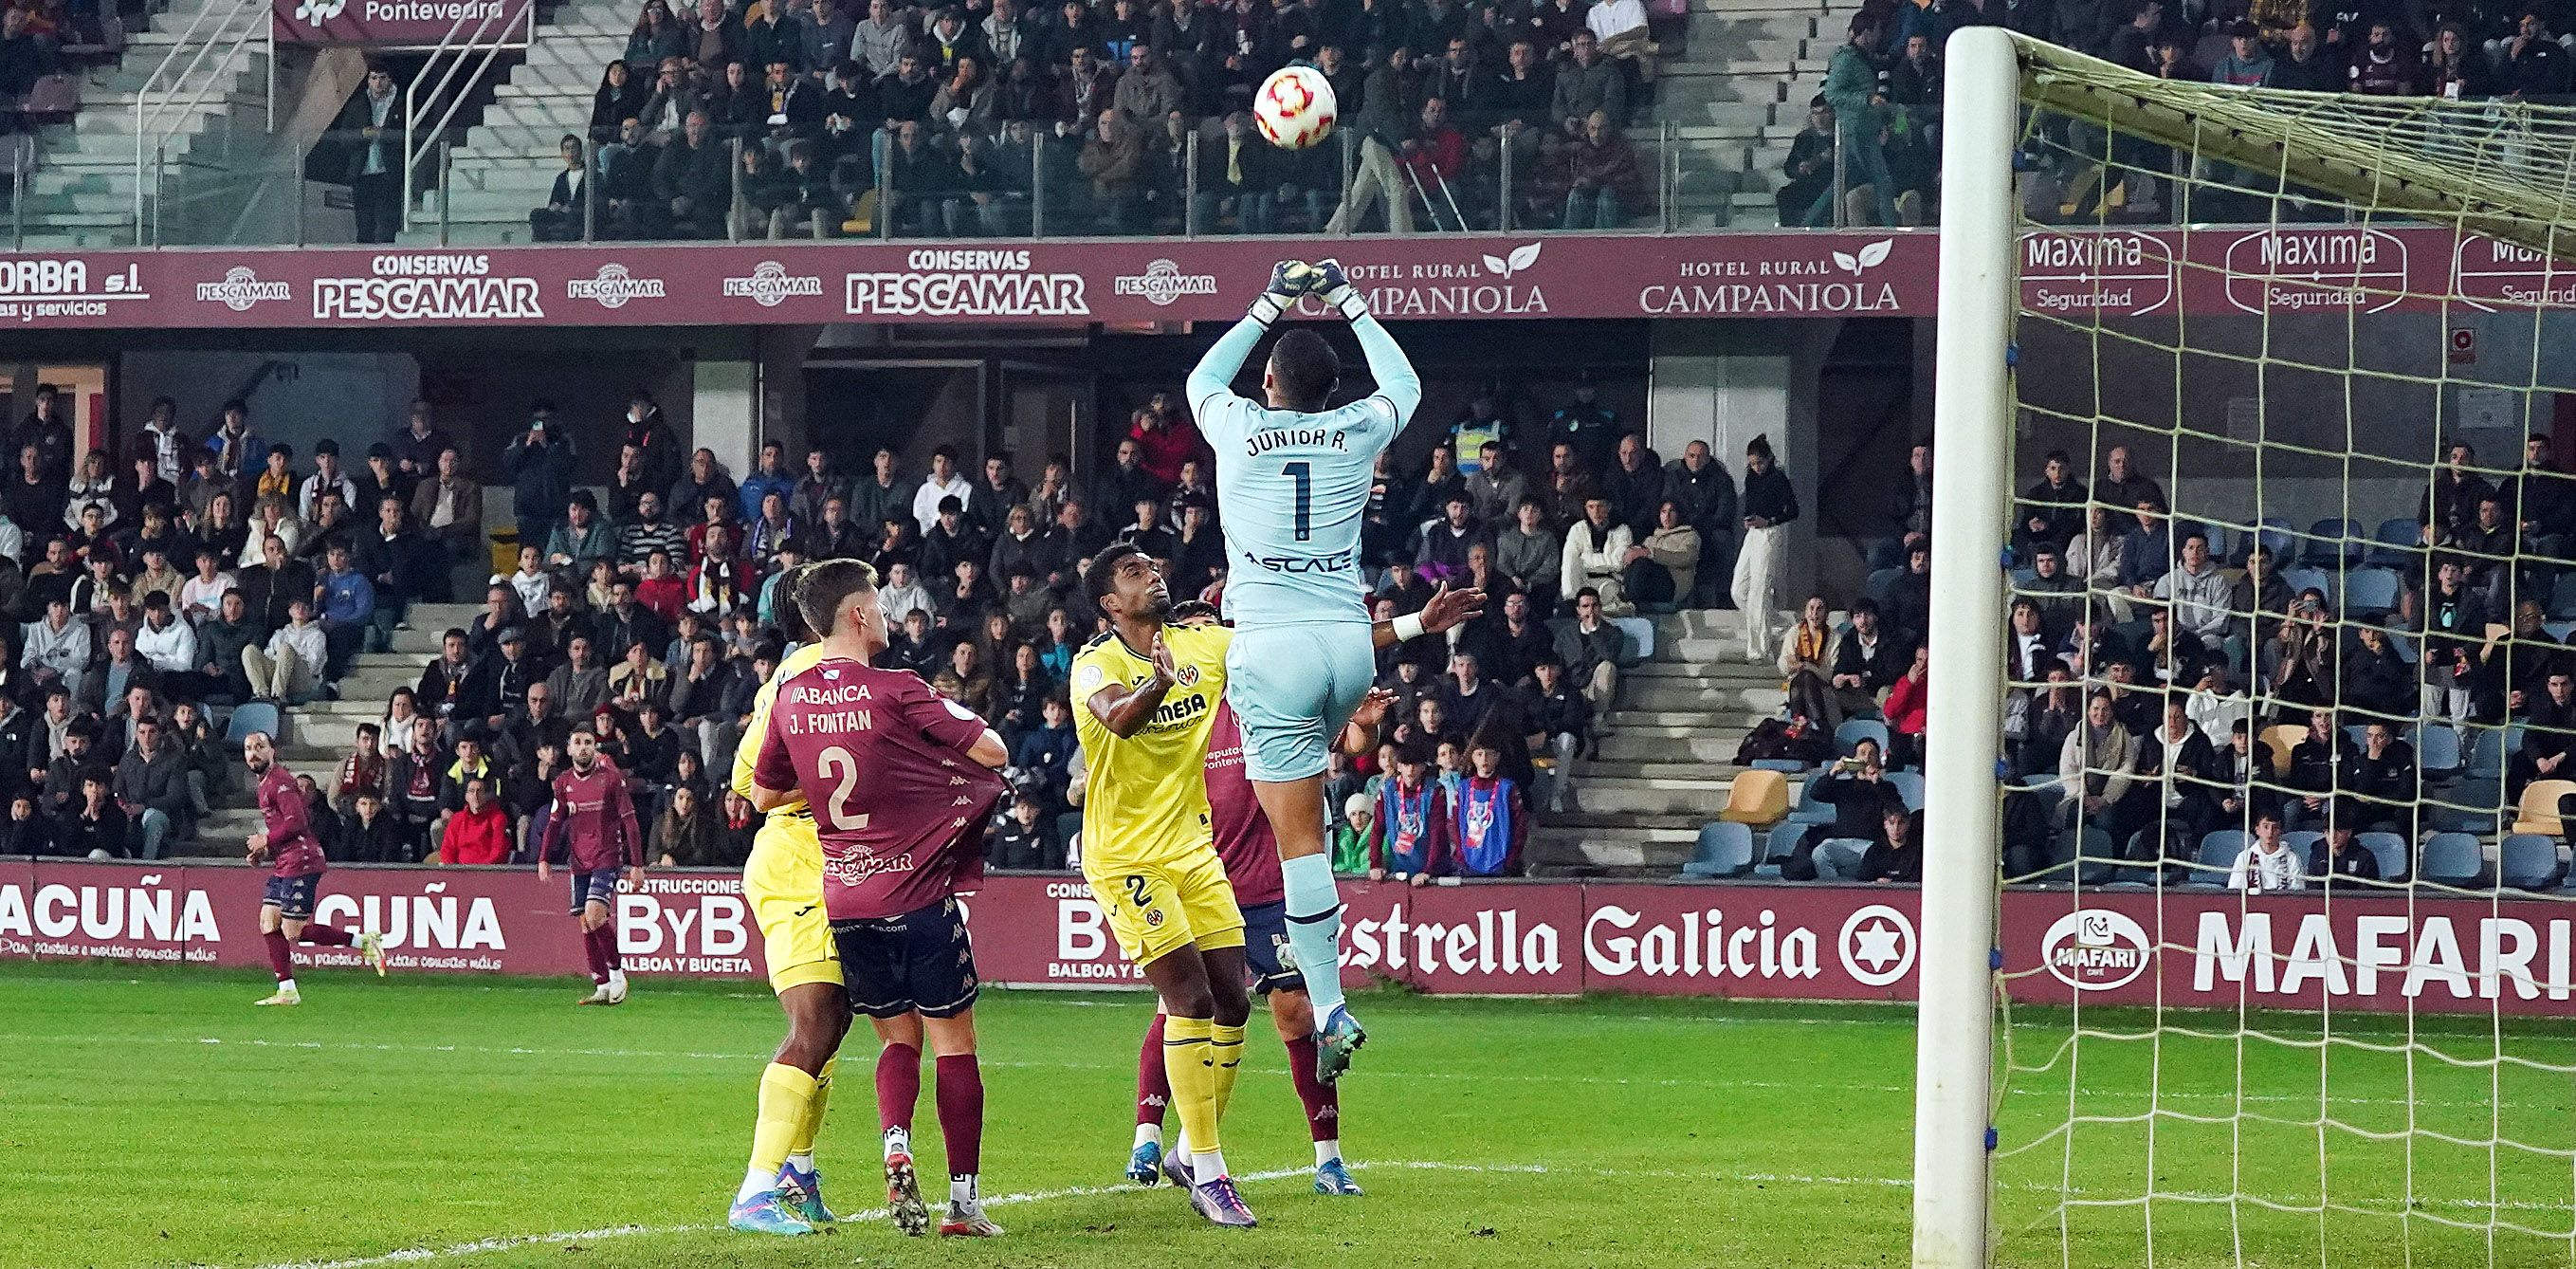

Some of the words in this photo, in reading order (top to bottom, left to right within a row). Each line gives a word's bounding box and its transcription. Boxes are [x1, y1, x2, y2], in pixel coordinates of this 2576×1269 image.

[372, 255, 489, 275] CONSERVAS
[907, 250, 1031, 270] CONSERVAS
[1413, 264, 1481, 279] RURAL
[1681, 262, 1750, 277] HOTEL
[1760, 261, 1830, 276] RURAL
[0, 259, 86, 293] ORBA
[104, 263, 142, 293] s.l.
[723, 275, 823, 296] PESCAMAR
[1115, 275, 1217, 295] PESCAMAR
[197, 282, 290, 300] PESCAMAR
[314, 279, 544, 319] PESCAMAR
[568, 279, 666, 299] PESCAMAR
[846, 273, 1089, 316] PESCAMAR
[1638, 283, 1900, 315] CAMPANIOLA
[2037, 288, 2132, 311] Seguridad
[2270, 287, 2366, 310] Seguridad
[22, 303, 32, 322] y
[36, 301, 107, 316] servicios
[1280, 461, 1311, 542] 1
[1153, 693, 1207, 724] MESA
[789, 715, 804, 735] J.
[808, 709, 872, 734] FONTAN
[817, 745, 869, 831] 2
[825, 853, 914, 875] ESCAMAR
[616, 879, 745, 894] OSTRUCCIONE
[1125, 874, 1153, 907] 2
[0, 875, 221, 942] ACUÑA
[301, 882, 506, 950] CUÑA
[1583, 905, 1821, 980] Galicia
[620, 957, 673, 972] ALBOA
[674, 958, 686, 972] Y
[689, 957, 753, 973] BUCETA
[2055, 947, 2136, 967] MAFARI
[2194, 911, 2573, 1002] MAFARI
[1049, 963, 1117, 978] BALBOA
[1118, 964, 1131, 978] Y
